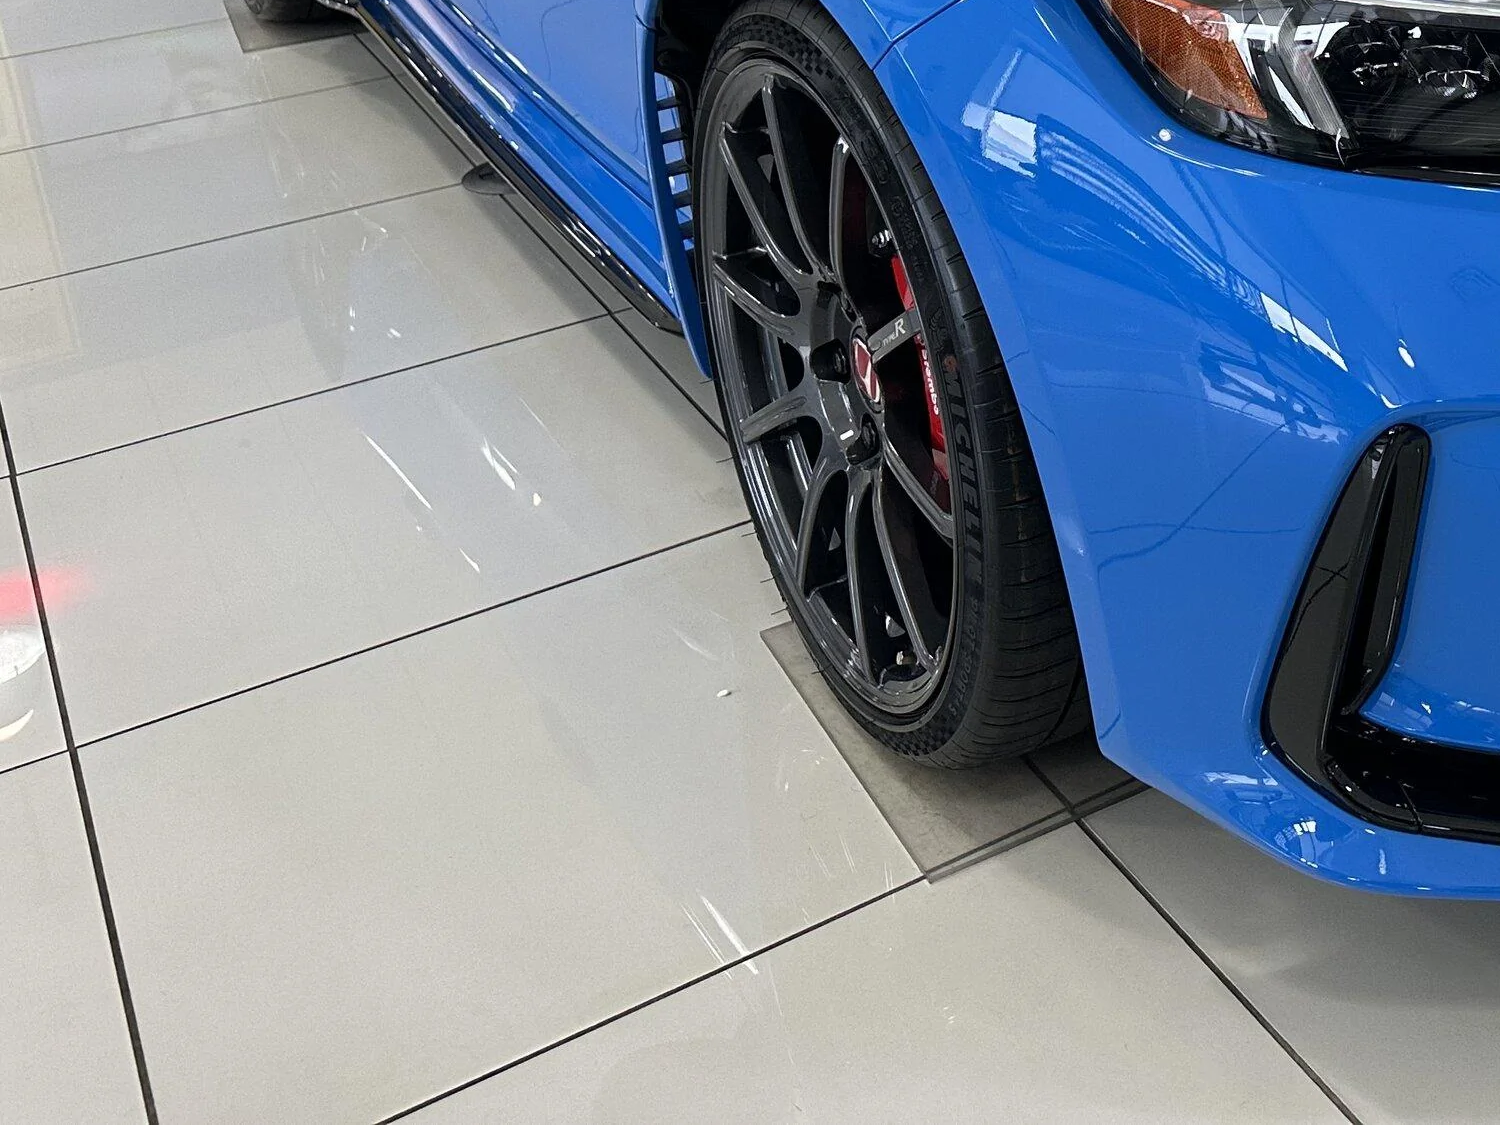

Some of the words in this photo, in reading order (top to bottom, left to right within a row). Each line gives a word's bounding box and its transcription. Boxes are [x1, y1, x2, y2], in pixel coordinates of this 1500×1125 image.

[894, 318, 906, 338] R
[921, 349, 940, 416] brembo
[944, 368, 984, 587] MICHELIN
